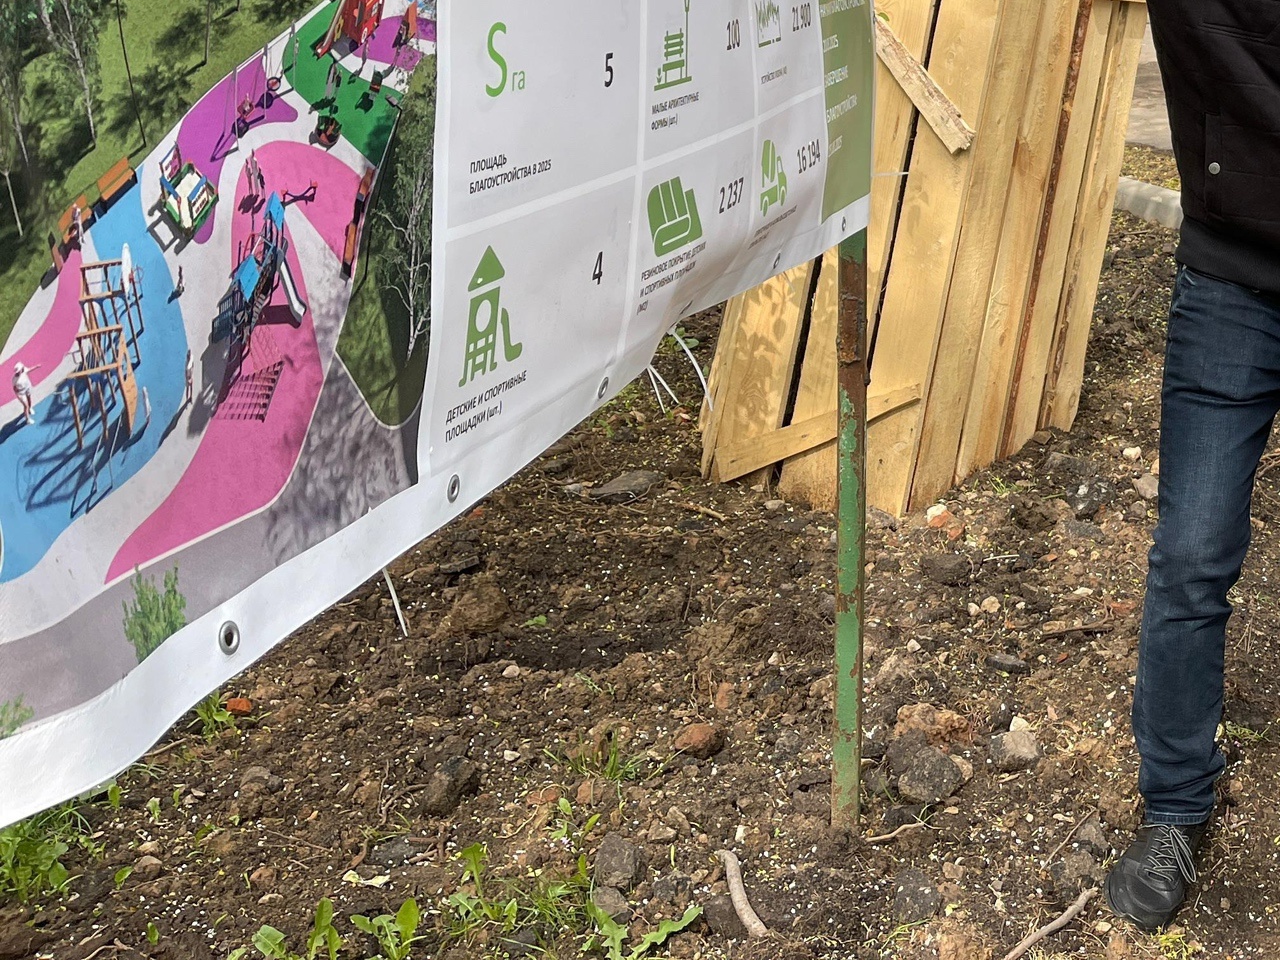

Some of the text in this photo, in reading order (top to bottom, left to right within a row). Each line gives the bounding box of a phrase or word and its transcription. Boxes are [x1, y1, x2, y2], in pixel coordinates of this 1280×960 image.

[726, 19, 741, 51] 100
[485, 22, 508, 98] S
[604, 52, 614, 88] 5
[511, 70, 526, 91] га
[651, 101, 668, 115] МАЛЫЕ
[651, 118, 668, 131] ФОРМЫ
[470, 153, 508, 175] ПЛОЩАДЬ
[797, 146, 807, 174] 16
[808, 139, 820, 168] 194
[469, 158, 552, 195] БЛАГОУСТРОЙСТВА В 2025
[718, 177, 744, 214] 2 237
[592, 251, 603, 285] 4
[641, 261, 668, 282] РЕЗИНОВОЕ
[668, 249, 692, 269] ПОКРЫТИЕ
[639, 287, 645, 298] И
[644, 273, 674, 296] СПОРТИВНЫХ
[446, 370, 527, 426] ДЕТСКИЕ И СПОРТИВНЫЕ
[445, 400, 503, 443] ПЛОЩАДКИ (шт.)
